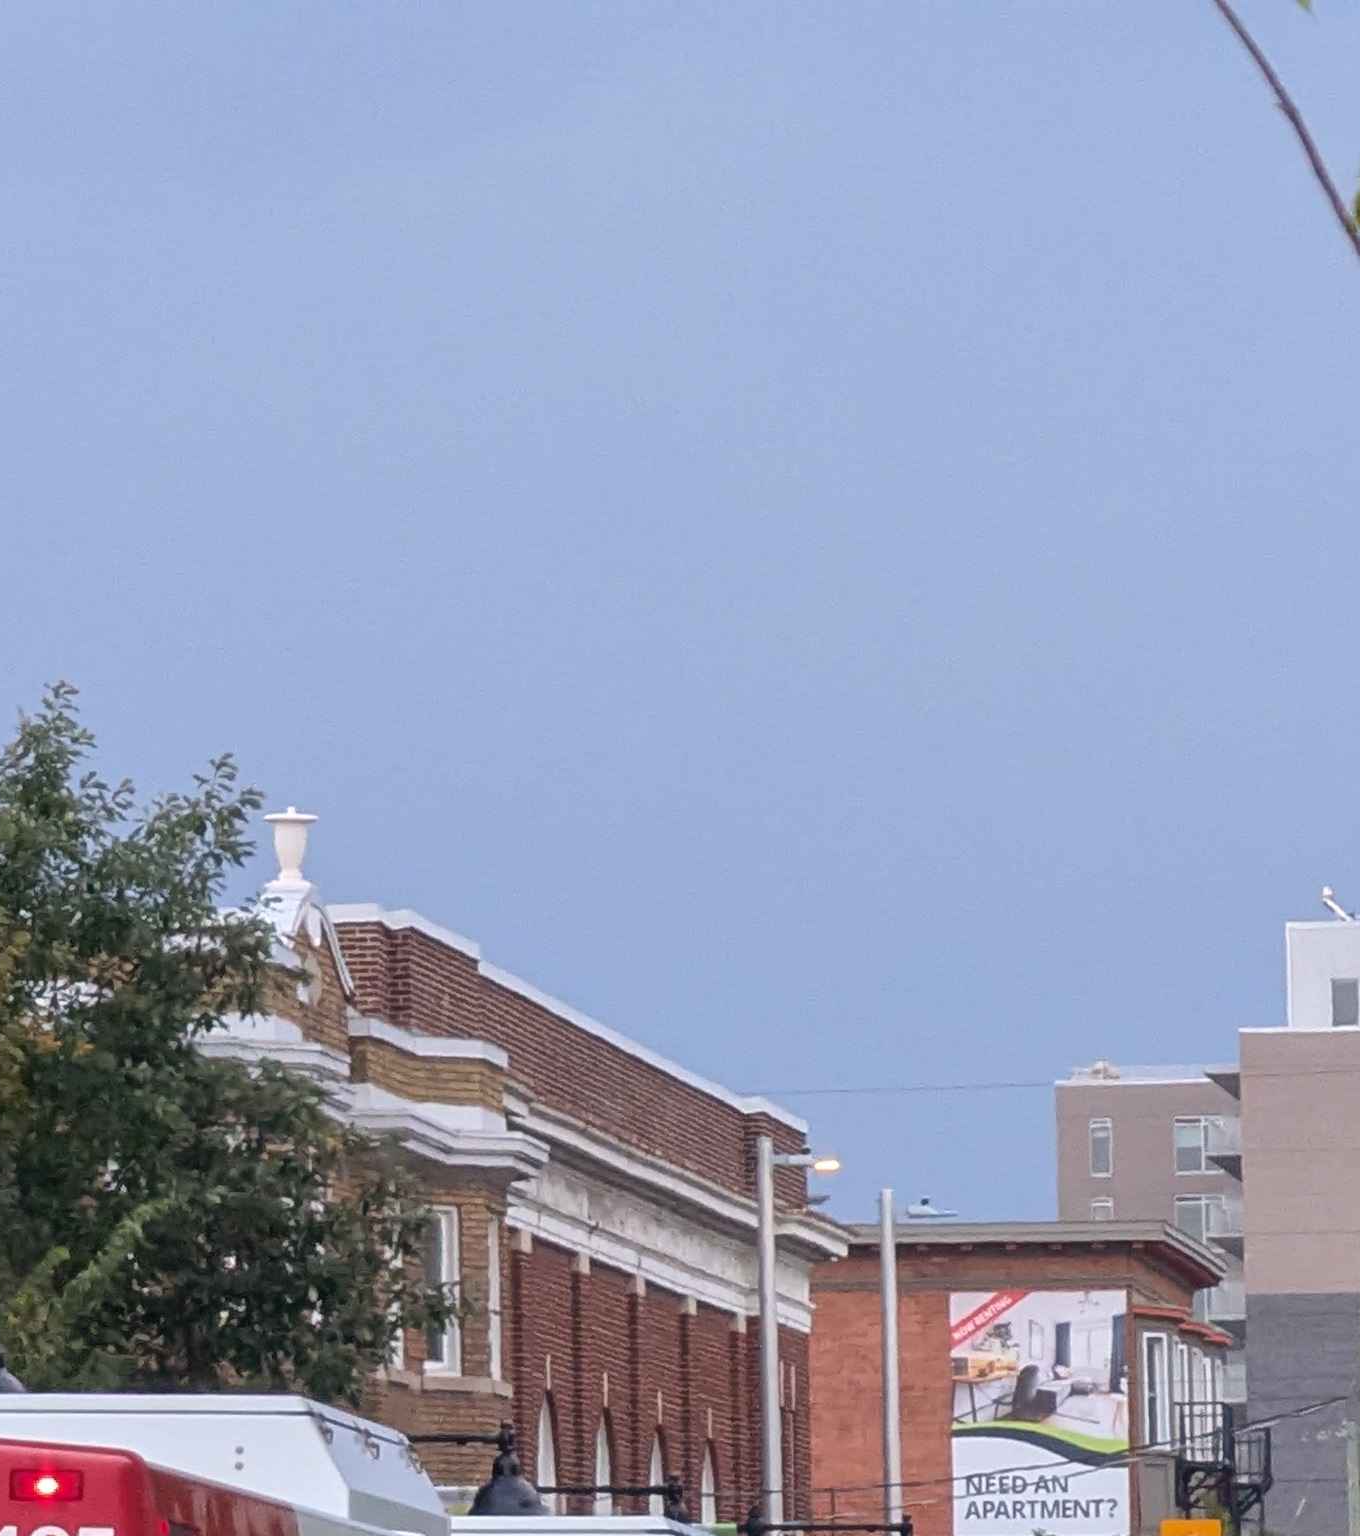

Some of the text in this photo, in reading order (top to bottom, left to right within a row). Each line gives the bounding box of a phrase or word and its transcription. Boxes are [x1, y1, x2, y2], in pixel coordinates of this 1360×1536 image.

[965, 1474, 1069, 1494] NEED AN
[964, 1498, 1118, 1521] APARTMENT?
